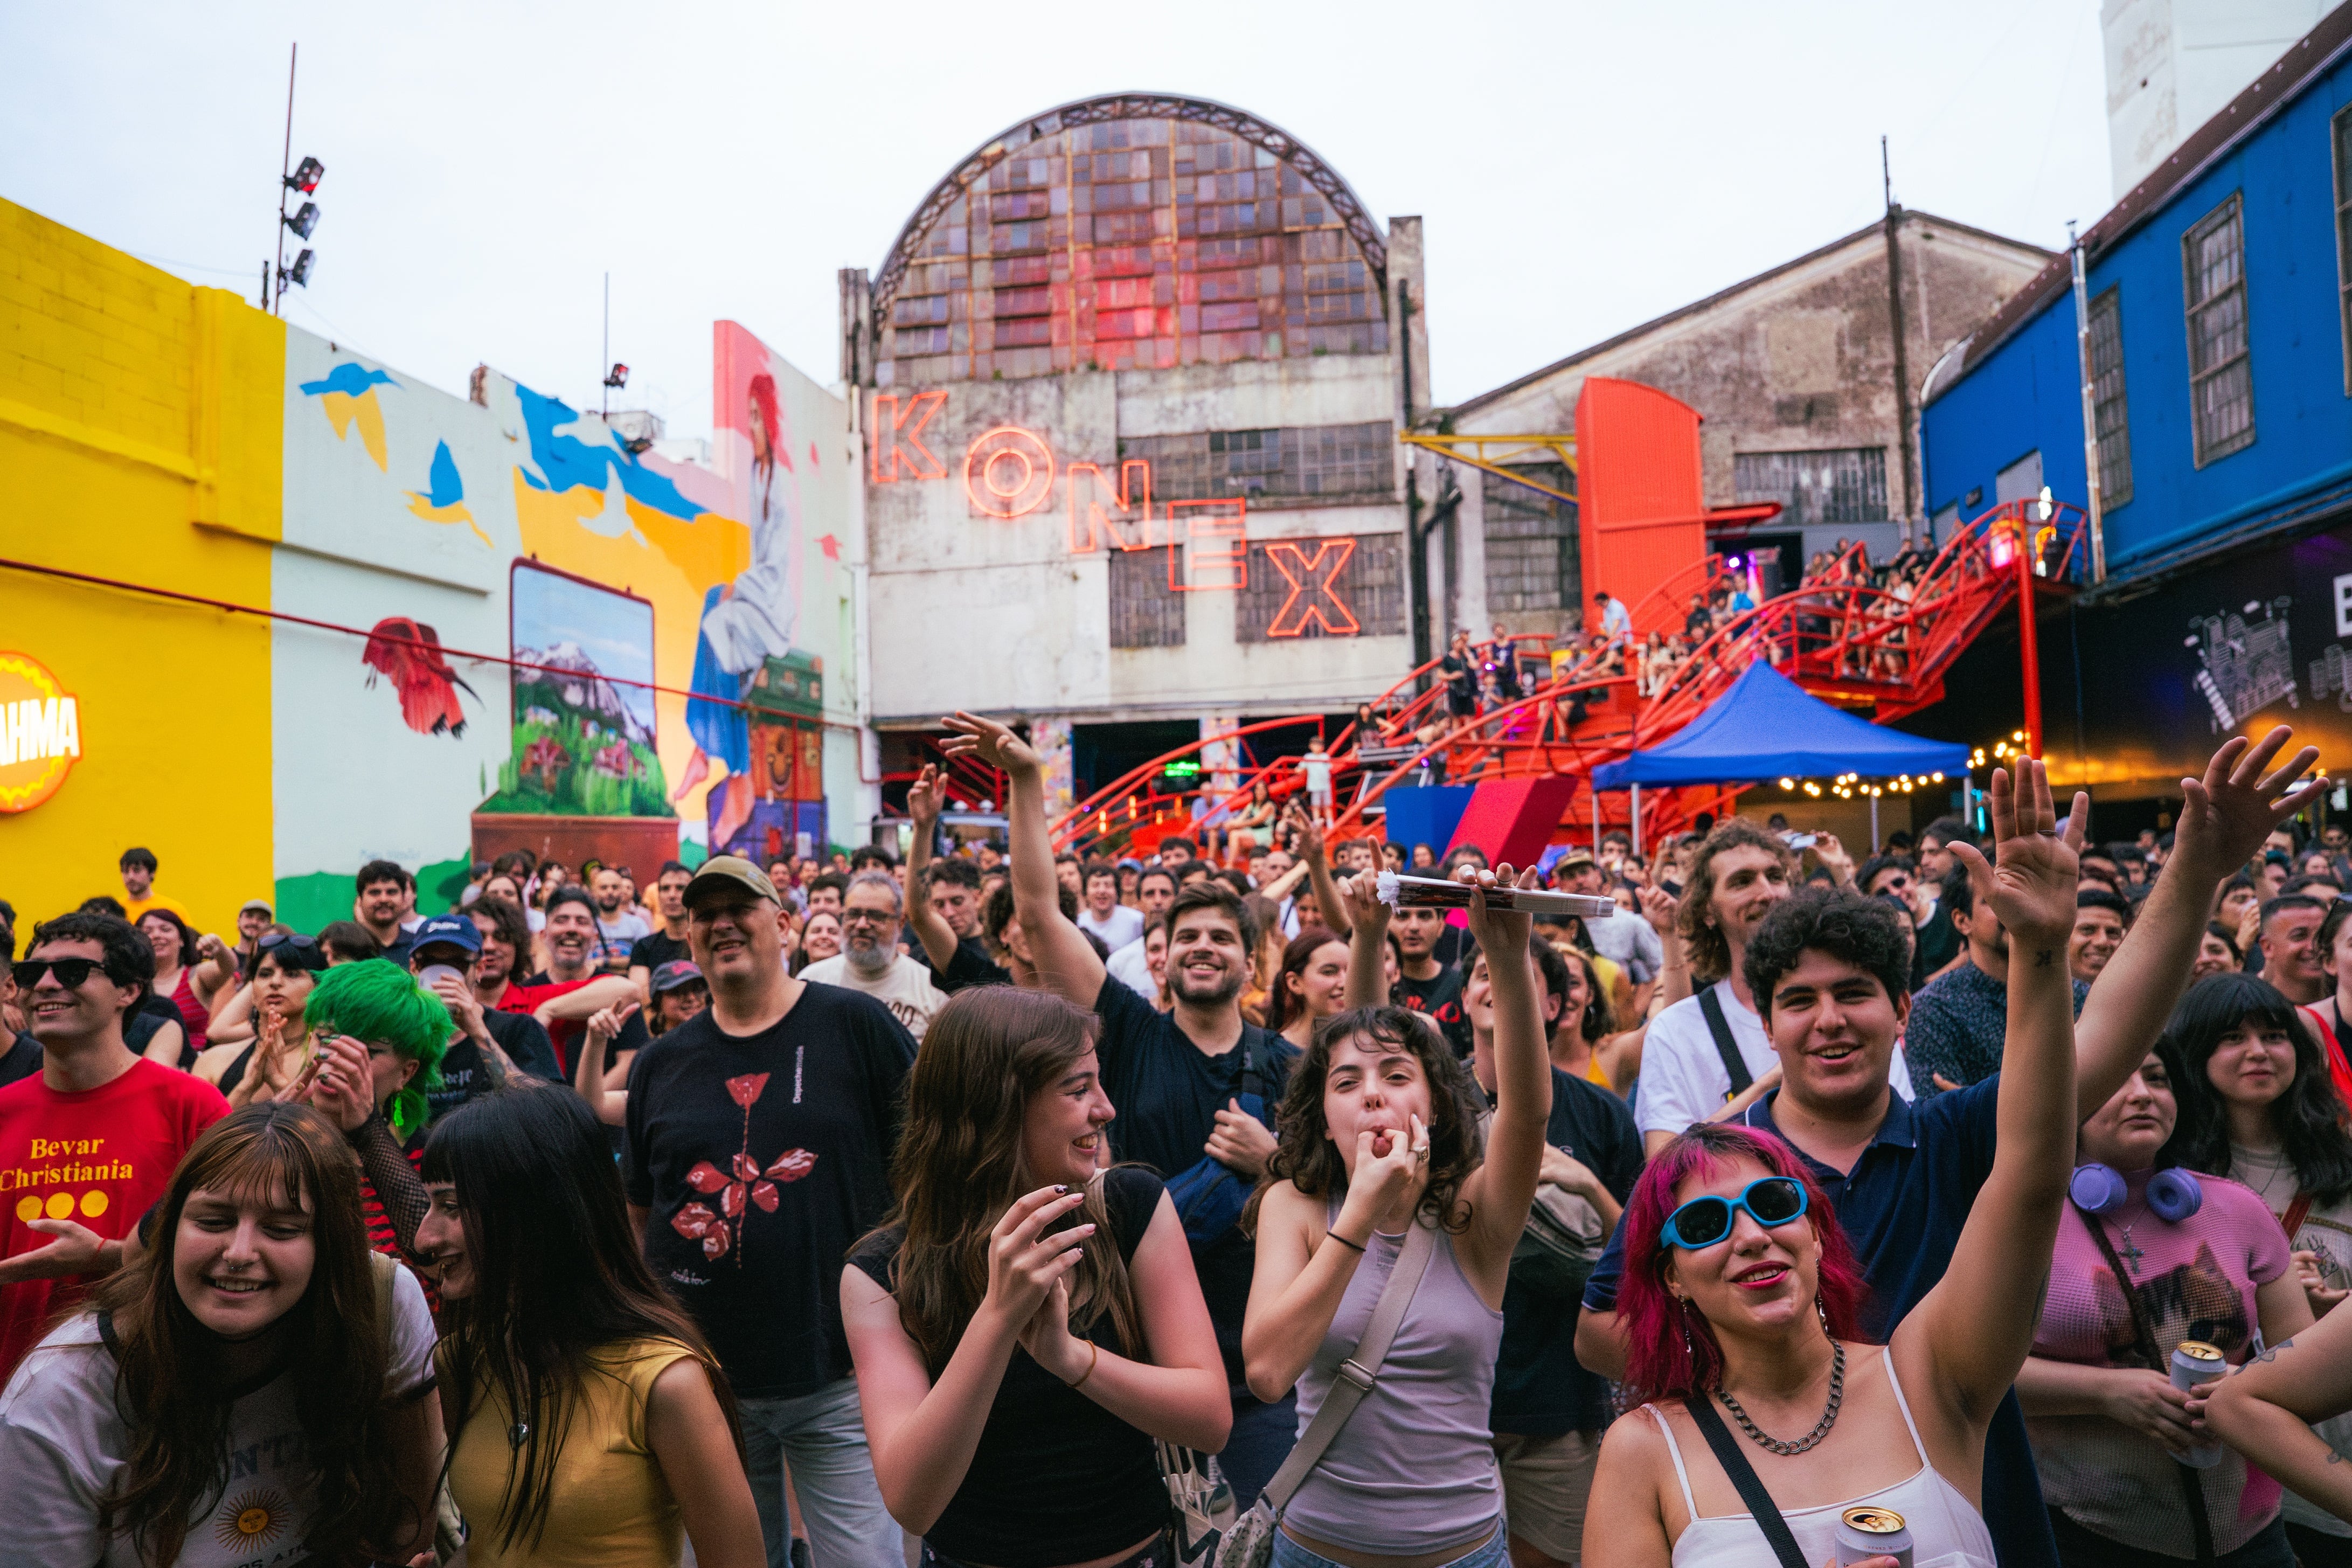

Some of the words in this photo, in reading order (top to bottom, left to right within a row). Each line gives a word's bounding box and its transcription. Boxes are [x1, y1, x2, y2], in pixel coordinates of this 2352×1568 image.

[871, 390, 1361, 637] KONEX
[30, 1138, 105, 1159] Bevar
[0, 1159, 133, 1191] Christiania
